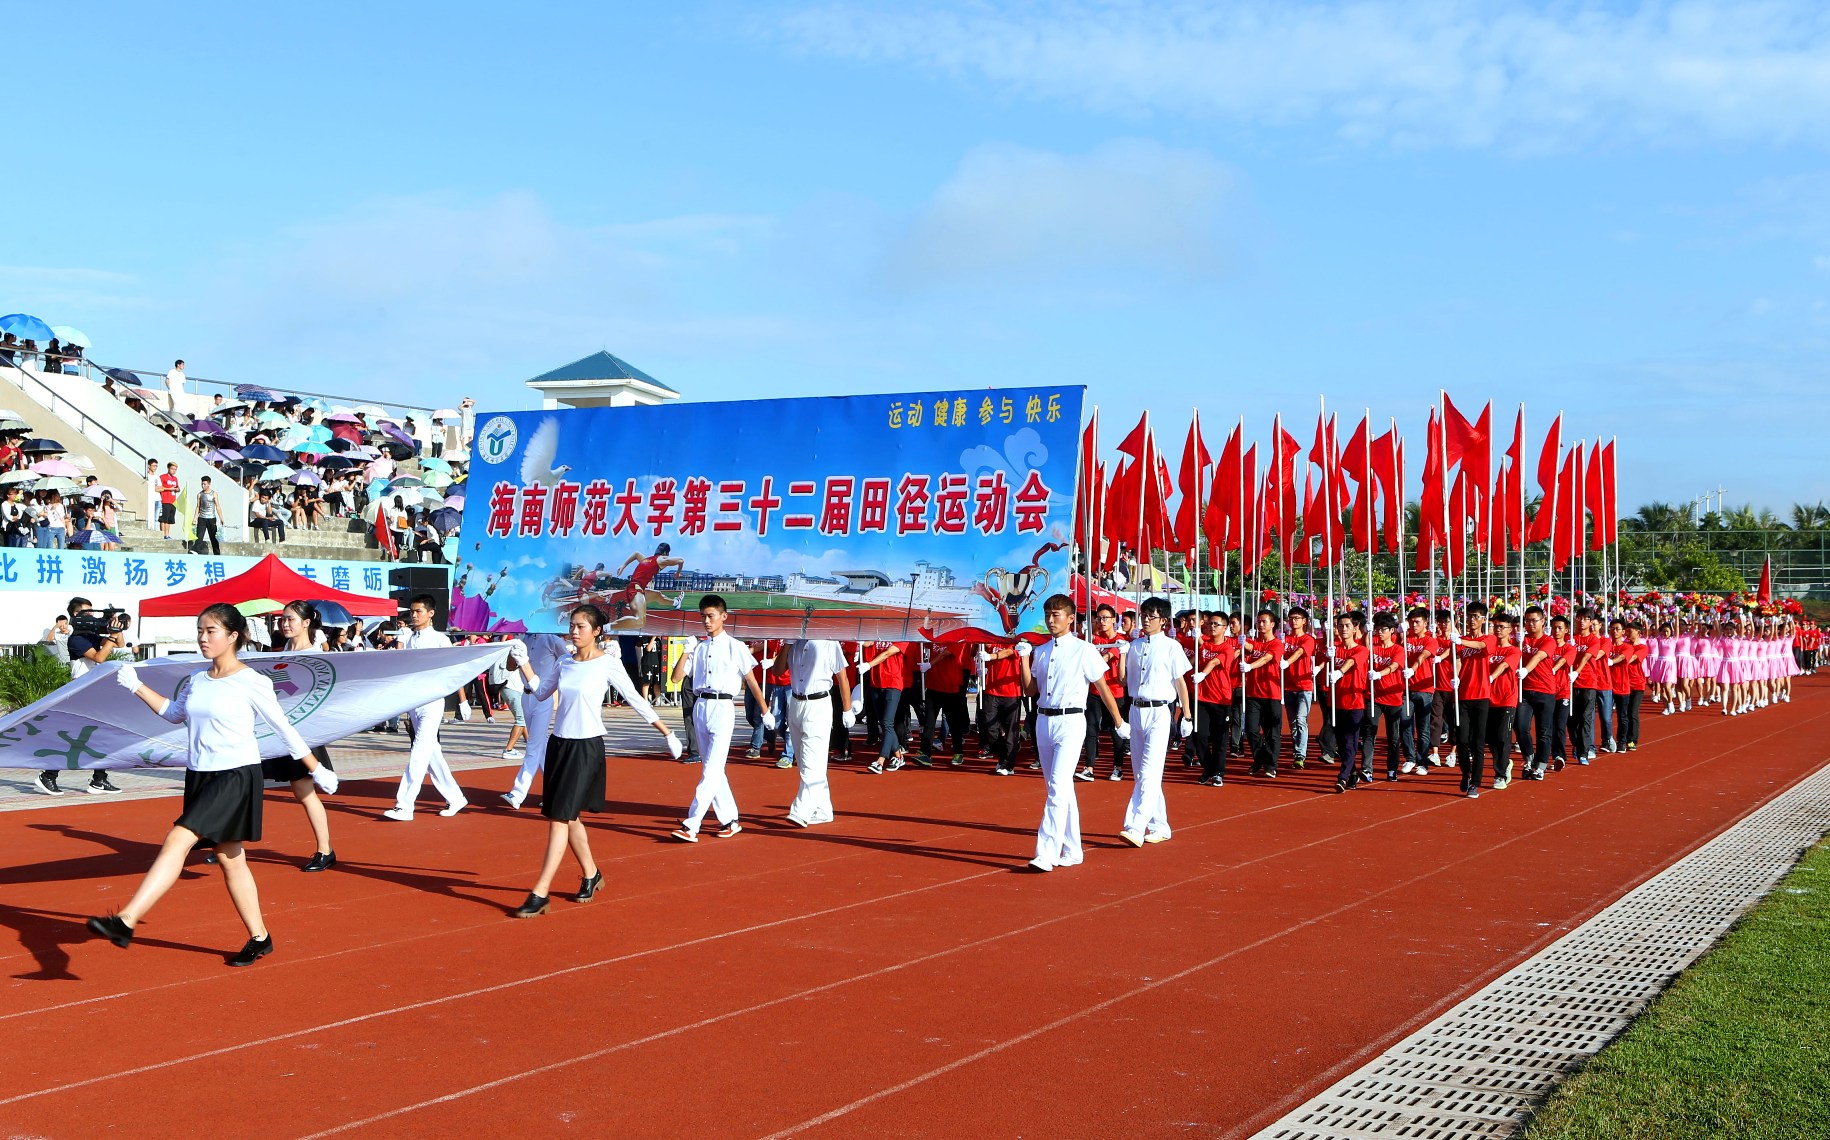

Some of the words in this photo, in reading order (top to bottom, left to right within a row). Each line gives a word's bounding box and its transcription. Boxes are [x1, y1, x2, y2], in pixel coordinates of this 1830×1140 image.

[888, 400, 922, 428] 运动
[934, 397, 967, 427] 健康
[978, 396, 1013, 425] 参与
[1026, 393, 1061, 423] 快乐
[488, 471, 1051, 537] 海南师范大学第三十二届田径运动会
